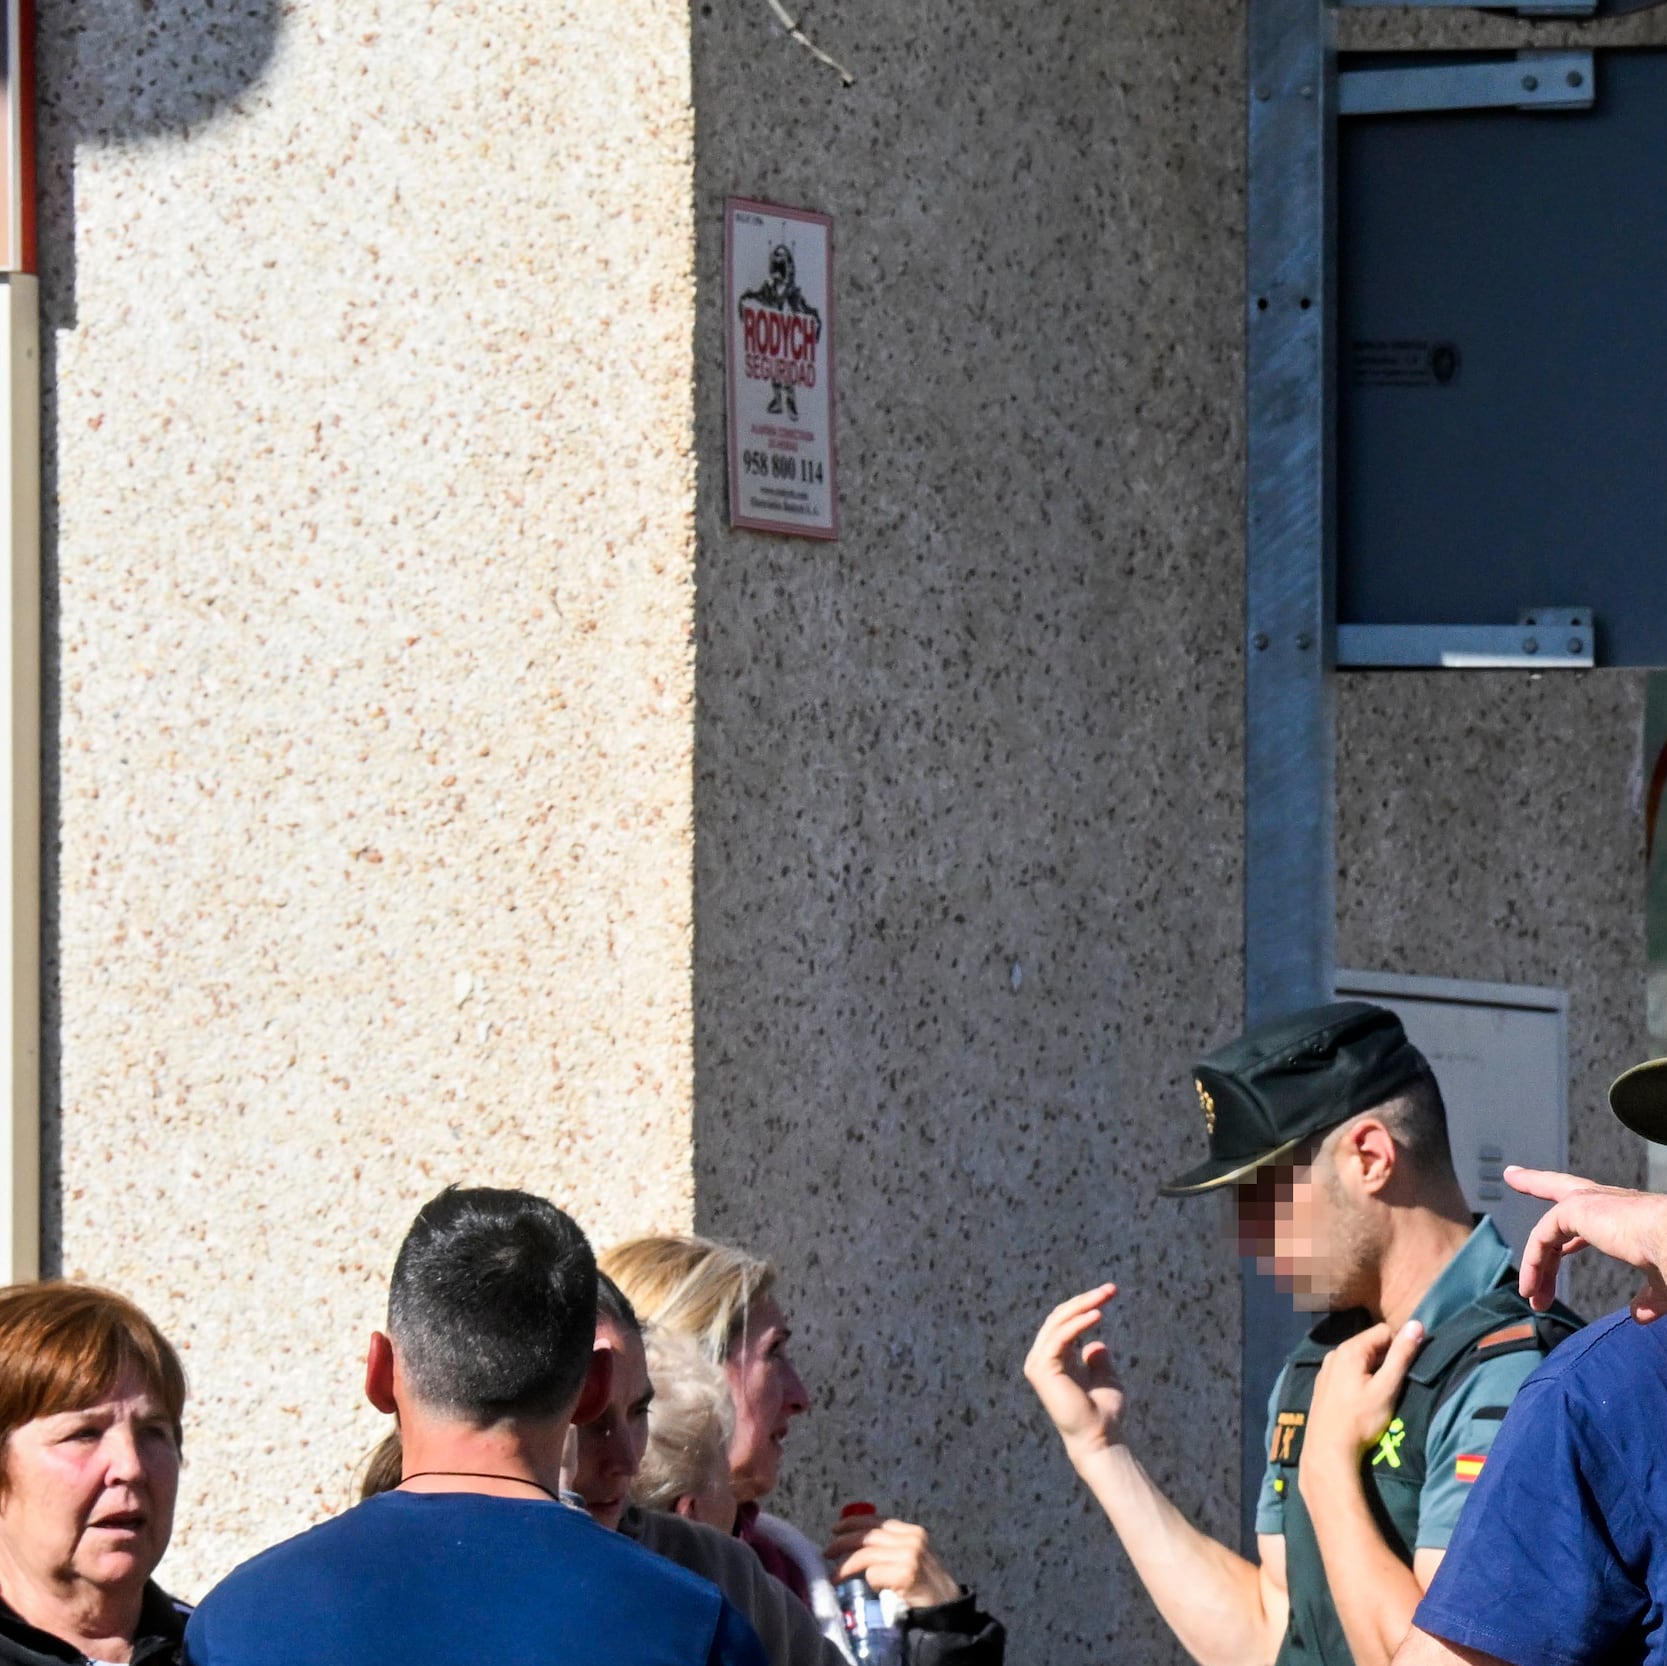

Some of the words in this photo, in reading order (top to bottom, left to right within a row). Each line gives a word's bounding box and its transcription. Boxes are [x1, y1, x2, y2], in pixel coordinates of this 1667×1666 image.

[744, 308, 816, 362] RODYCH
[744, 353, 817, 388] SEGURIDAD
[743, 449, 769, 477] 958
[801, 458, 824, 485] 114
